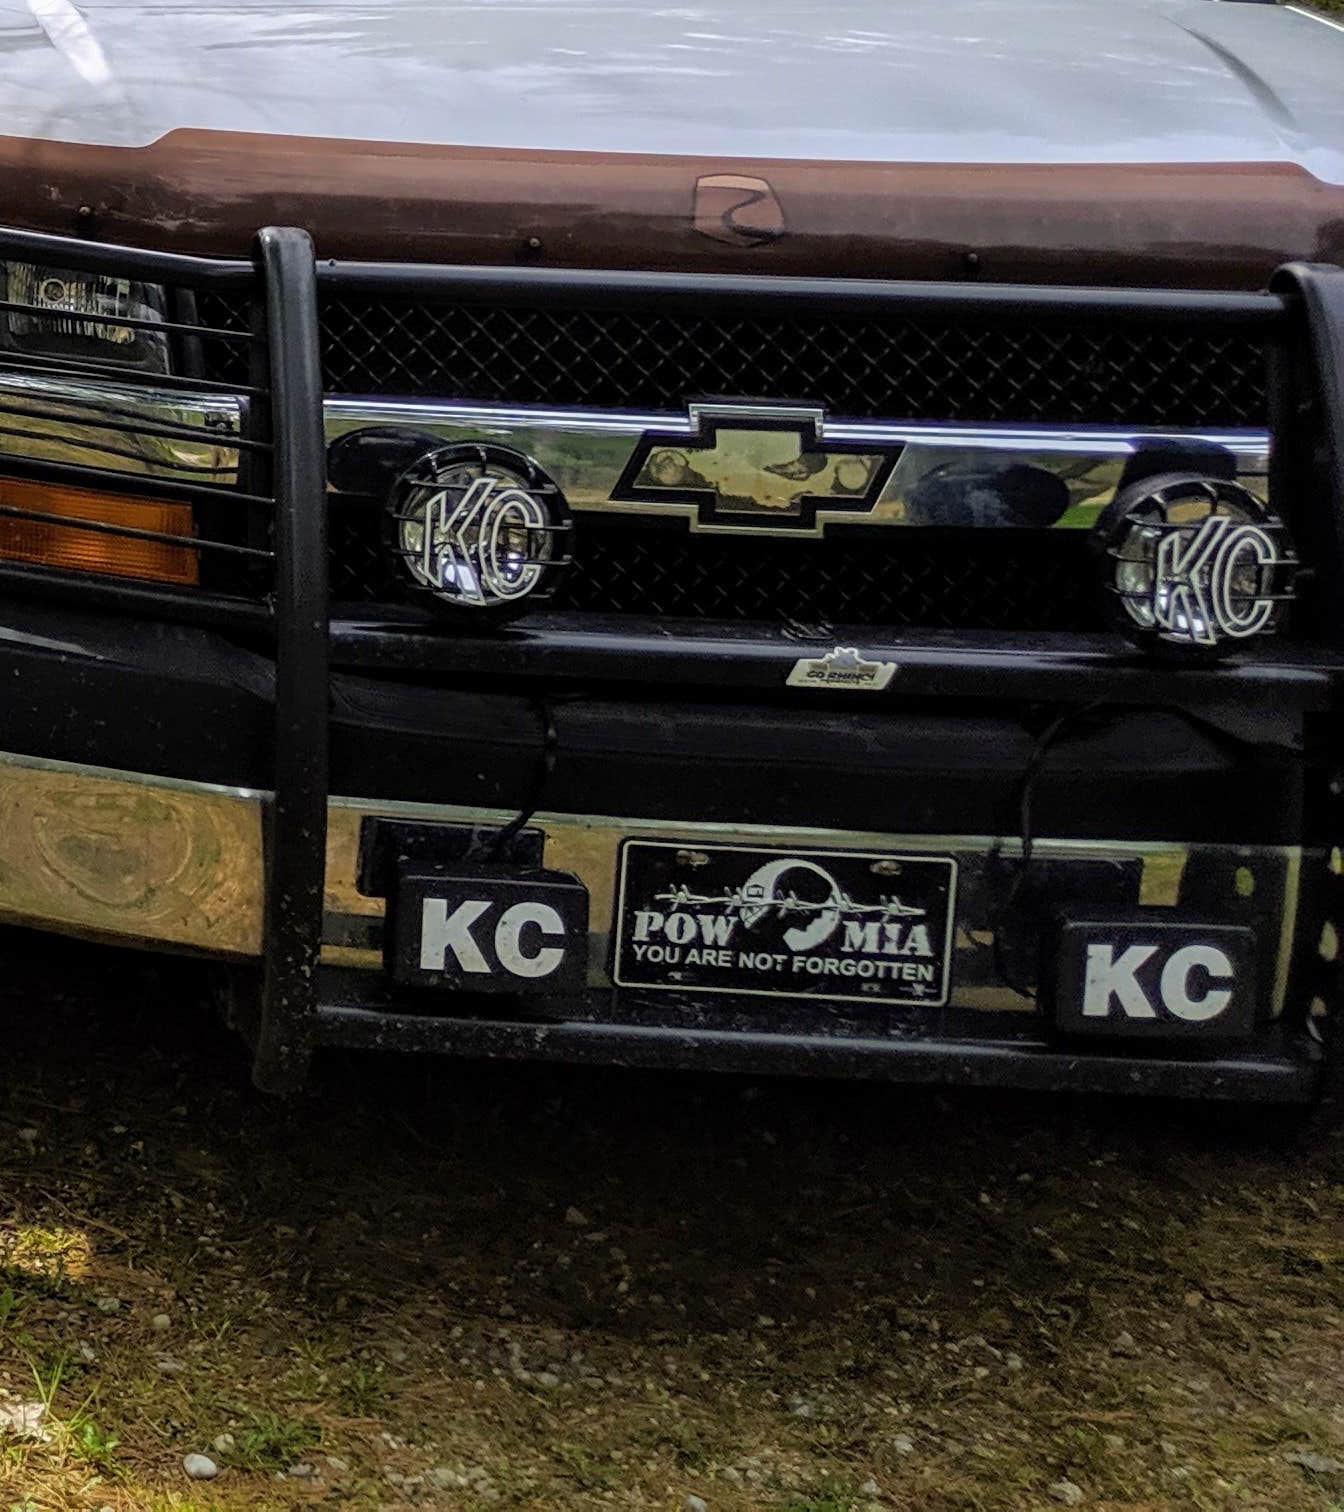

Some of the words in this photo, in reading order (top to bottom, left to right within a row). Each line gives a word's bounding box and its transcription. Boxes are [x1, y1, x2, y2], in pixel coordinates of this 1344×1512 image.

[424, 477, 545, 606] KC
[1154, 515, 1278, 645] KC
[421, 897, 566, 978] KC
[632, 910, 739, 947] POW
[841, 920, 934, 957] MIA
[632, 943, 680, 965] YOU
[685, 948, 733, 968] ARE
[738, 951, 787, 972] NOT
[792, 955, 935, 982] FORGOTTEN
[1082, 944, 1234, 1021] KC
